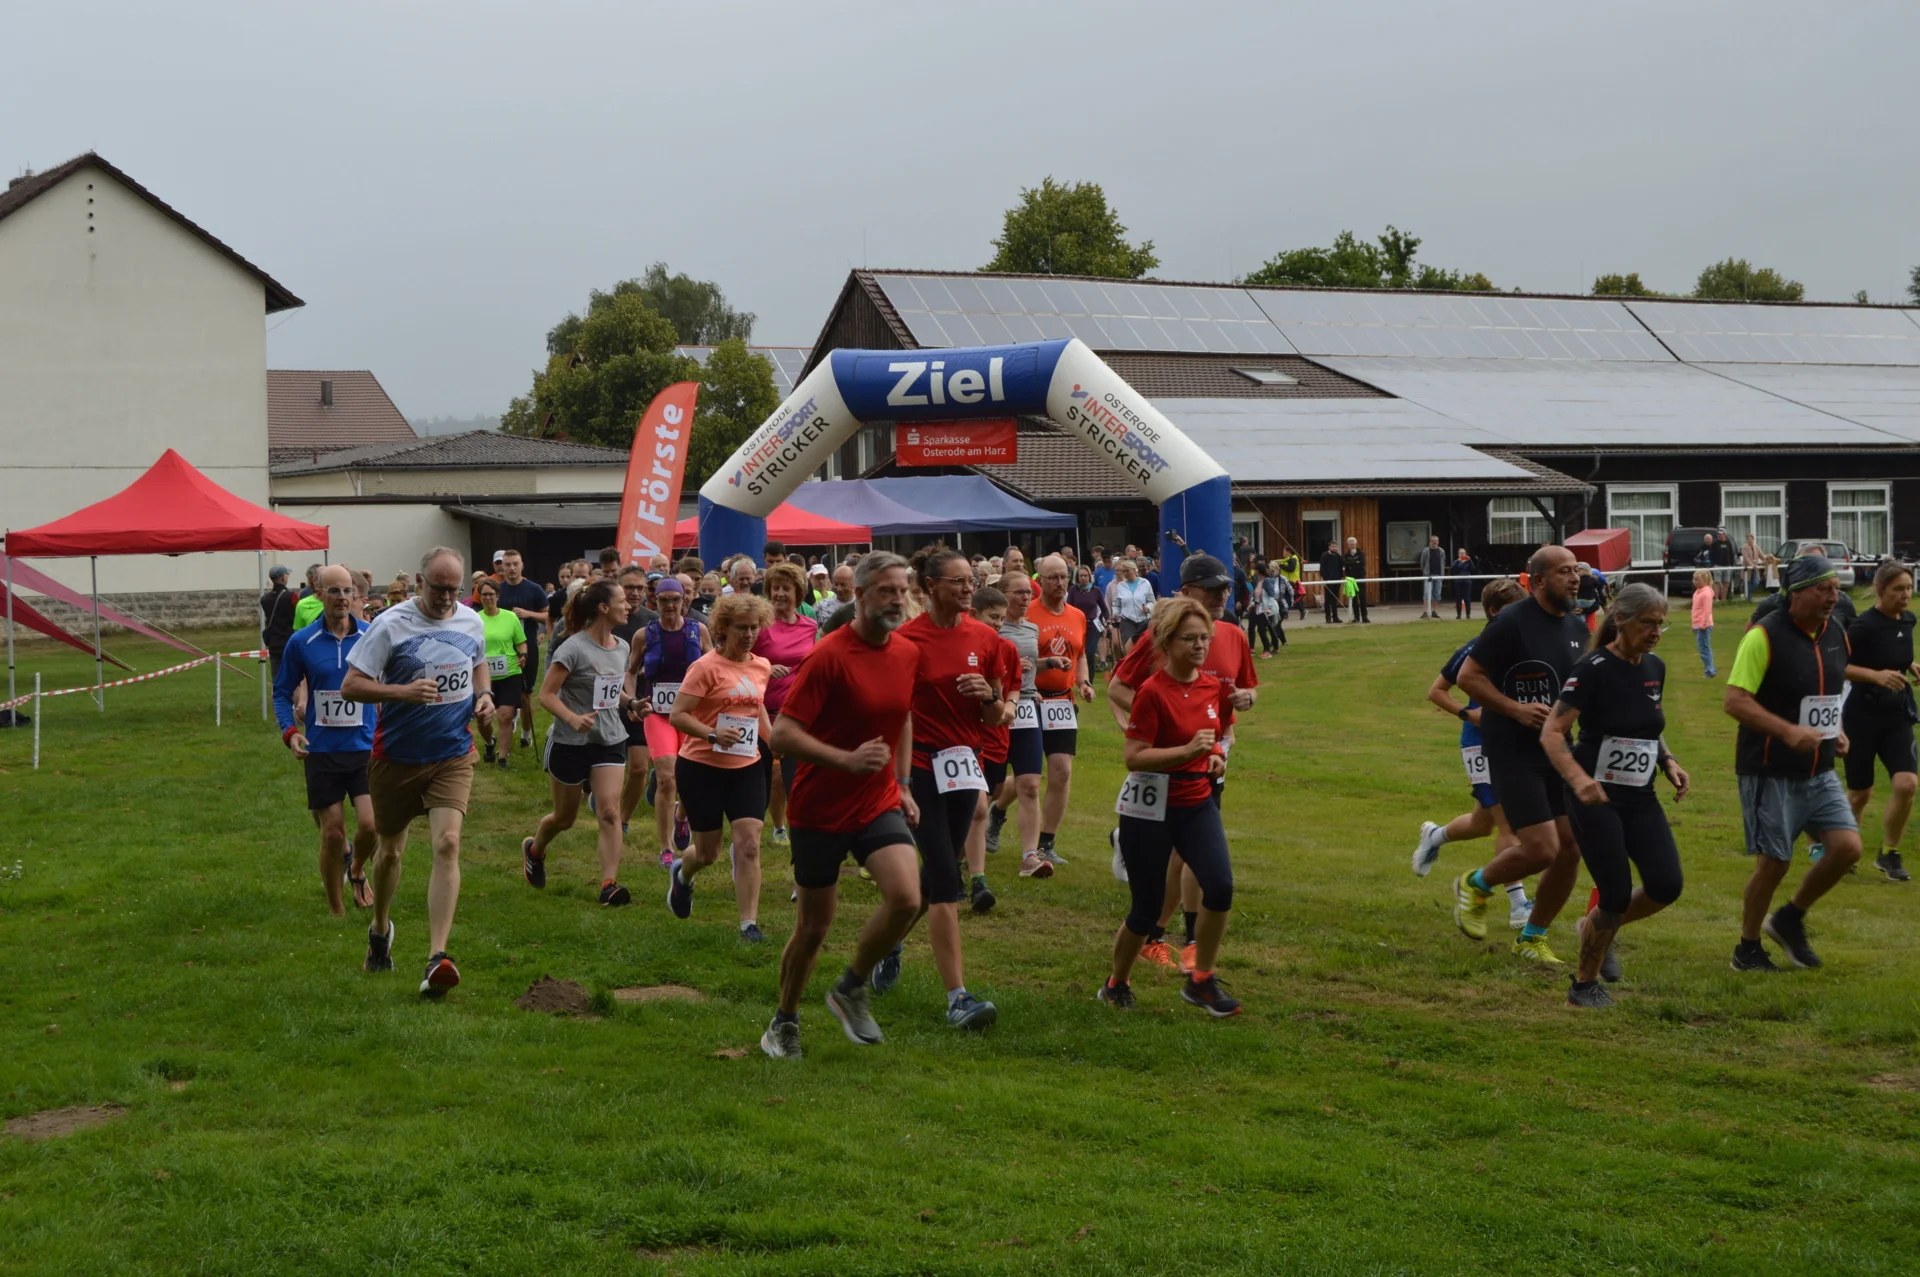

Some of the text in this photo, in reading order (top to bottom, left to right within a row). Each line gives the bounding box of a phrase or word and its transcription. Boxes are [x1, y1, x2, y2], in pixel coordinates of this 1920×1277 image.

[886, 357, 1005, 406] Ziel
[1104, 393, 1161, 443] OSTERODE
[741, 397, 818, 477] INTERSPORT
[742, 405, 792, 456] OSTERODE
[923, 435, 971, 446] Sparkasse
[1083, 396, 1169, 474] INTERSPORT
[747, 416, 830, 496] STRICKER
[923, 447, 1007, 457] Osterode am Harz
[1066, 406, 1151, 486] STRICKER
[637, 403, 684, 526] Förste
[436, 670, 469, 693] 262
[1515, 679, 1549, 693] RUN
[657, 691, 676, 705] 00
[723, 694, 763, 706] adidas
[322, 700, 356, 717] 170
[1016, 705, 1033, 719] 02
[1047, 707, 1072, 721] 003
[1809, 707, 1839, 727] 036
[733, 726, 754, 745] 24
[944, 758, 983, 778] 018
[1467, 756, 1486, 773] 19
[1607, 750, 1650, 773] 229
[1121, 781, 1157, 806] 216
